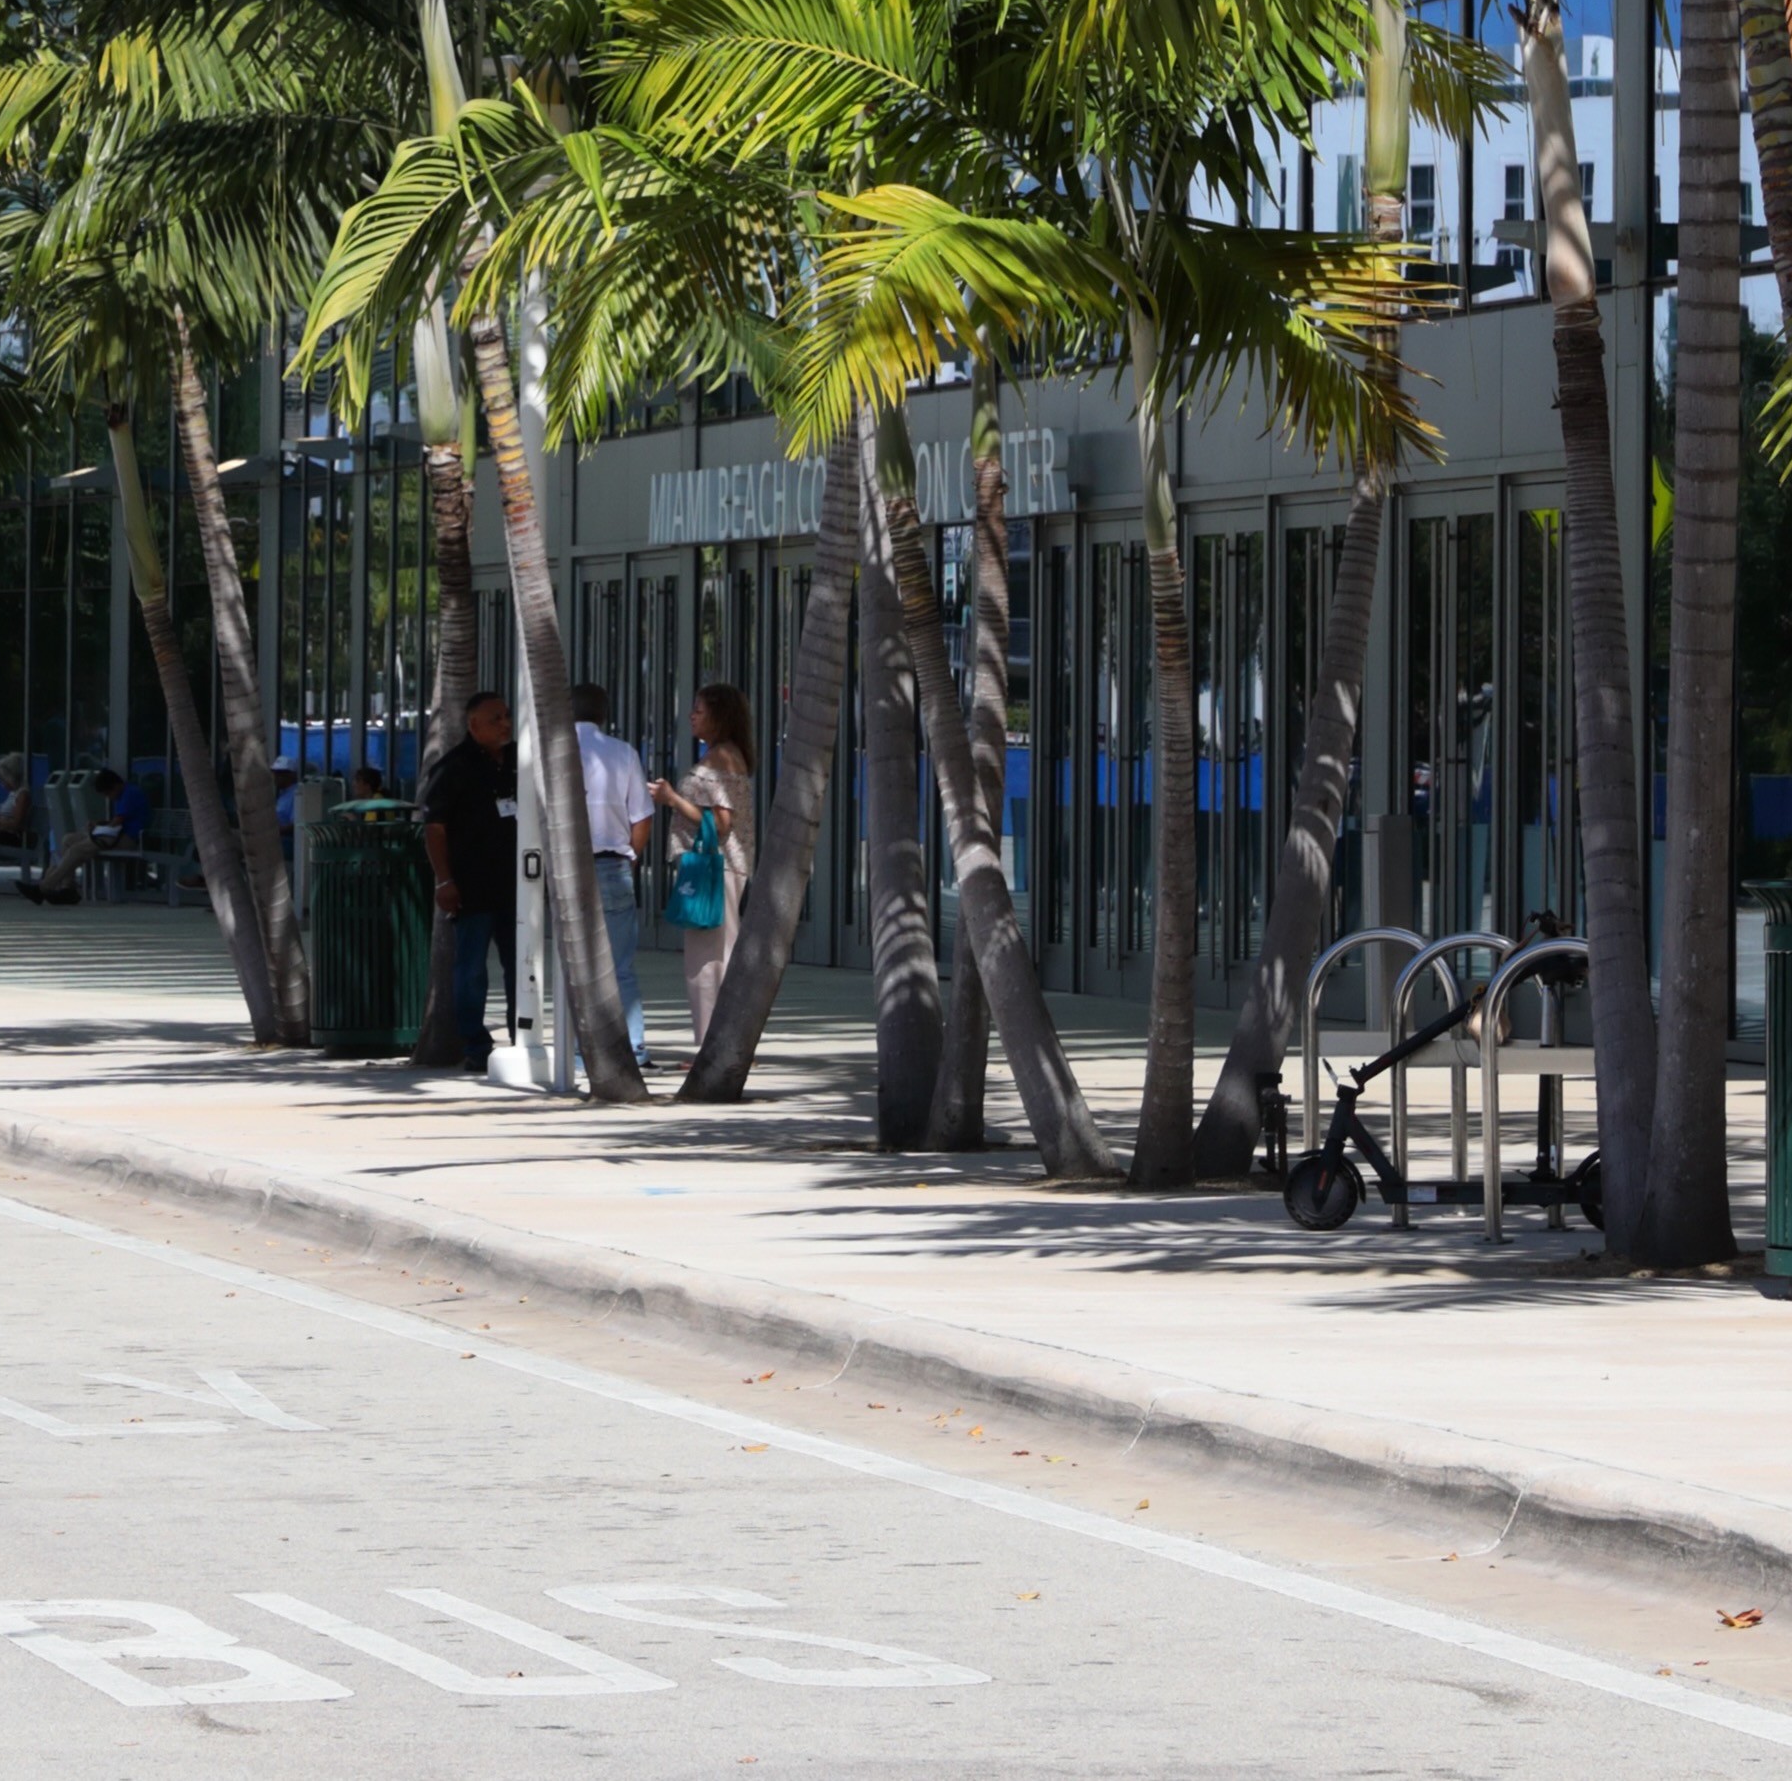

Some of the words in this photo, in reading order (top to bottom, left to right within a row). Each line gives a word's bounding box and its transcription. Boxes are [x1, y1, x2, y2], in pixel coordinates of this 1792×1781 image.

[648, 468, 710, 545] MIAMI
[718, 460, 786, 540] BEACH
[960, 427, 1057, 519] CTER
